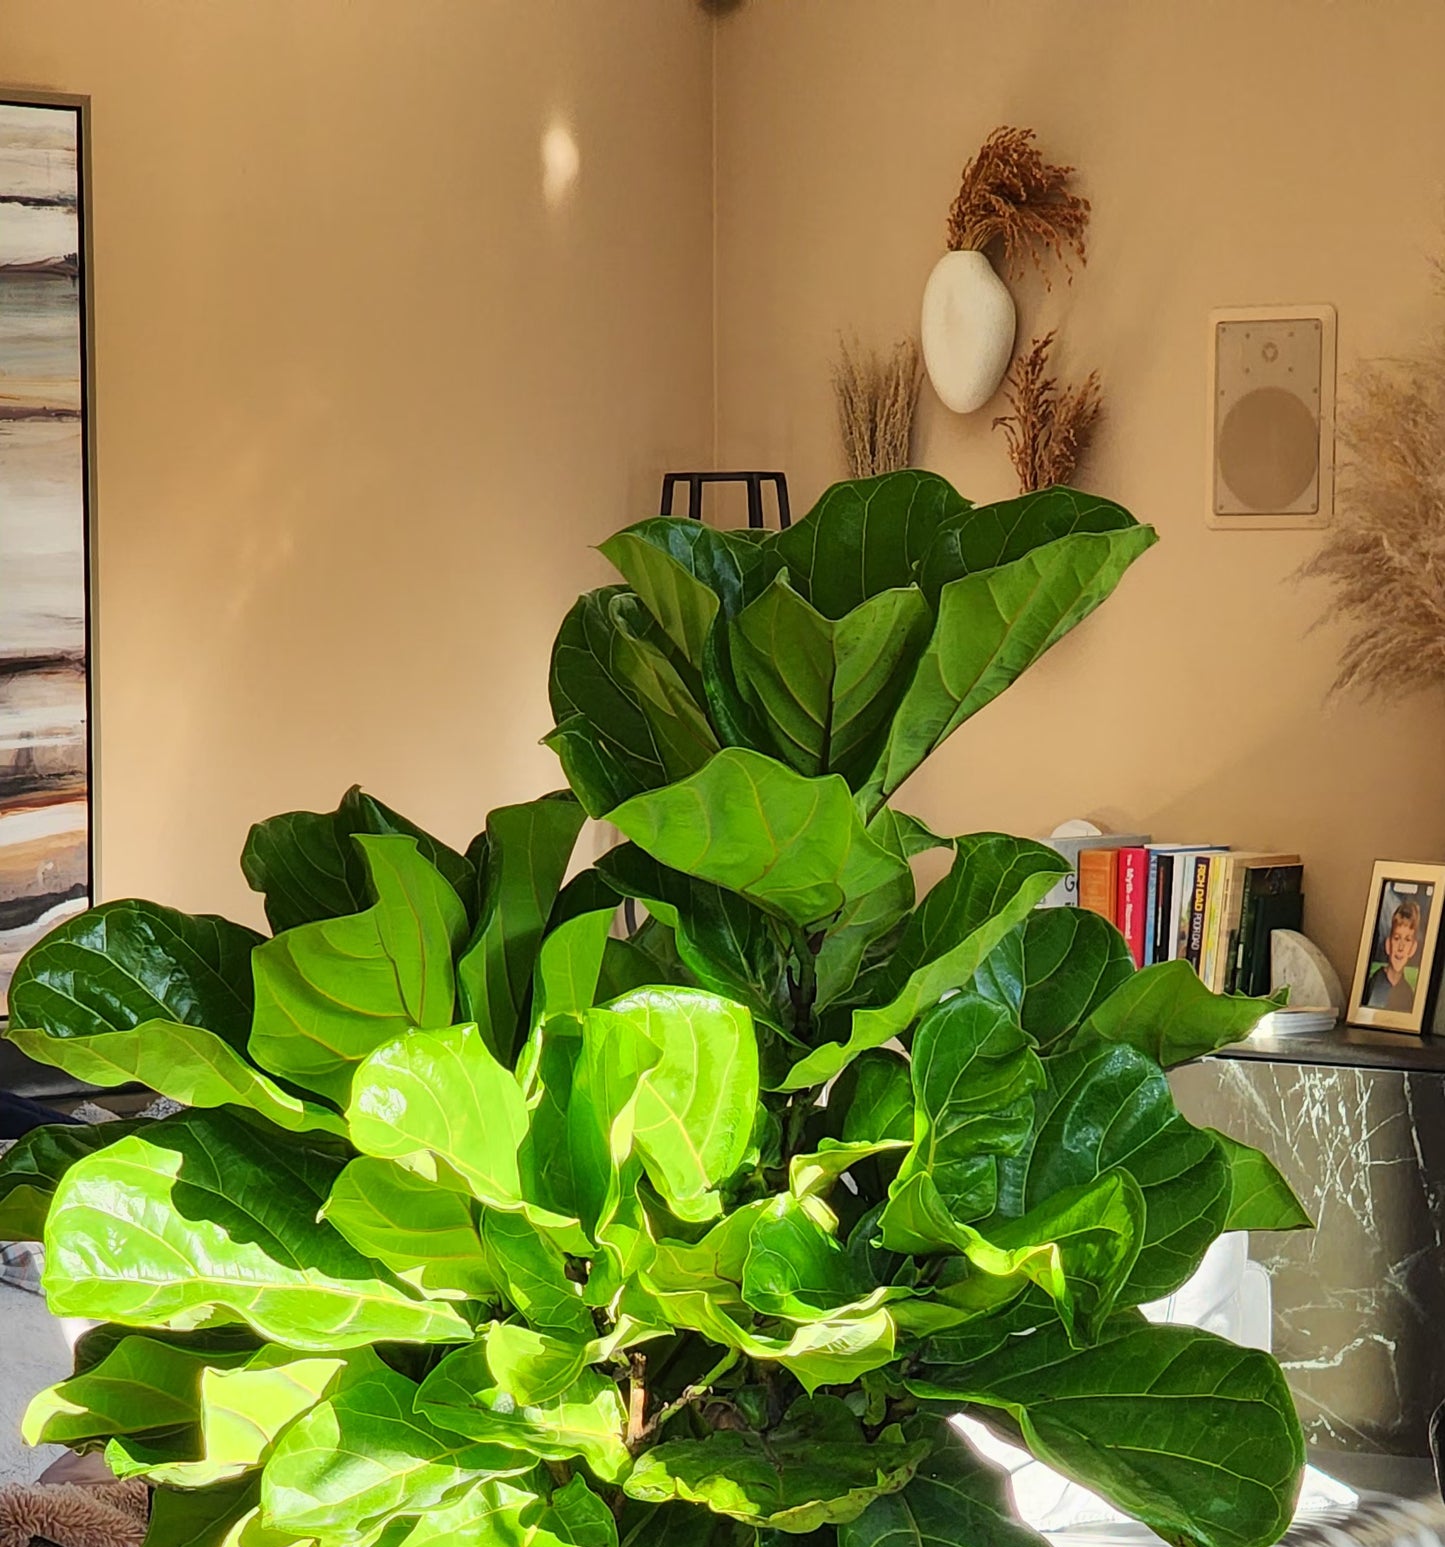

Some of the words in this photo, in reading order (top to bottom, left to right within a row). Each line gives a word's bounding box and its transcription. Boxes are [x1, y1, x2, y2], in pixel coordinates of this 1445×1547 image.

[1125, 868, 1134, 893] Myth
[1196, 863, 1206, 887] RICH
[1194, 888, 1204, 911] DAD
[1193, 912, 1202, 933] POOR
[1191, 934, 1200, 950] DAD
